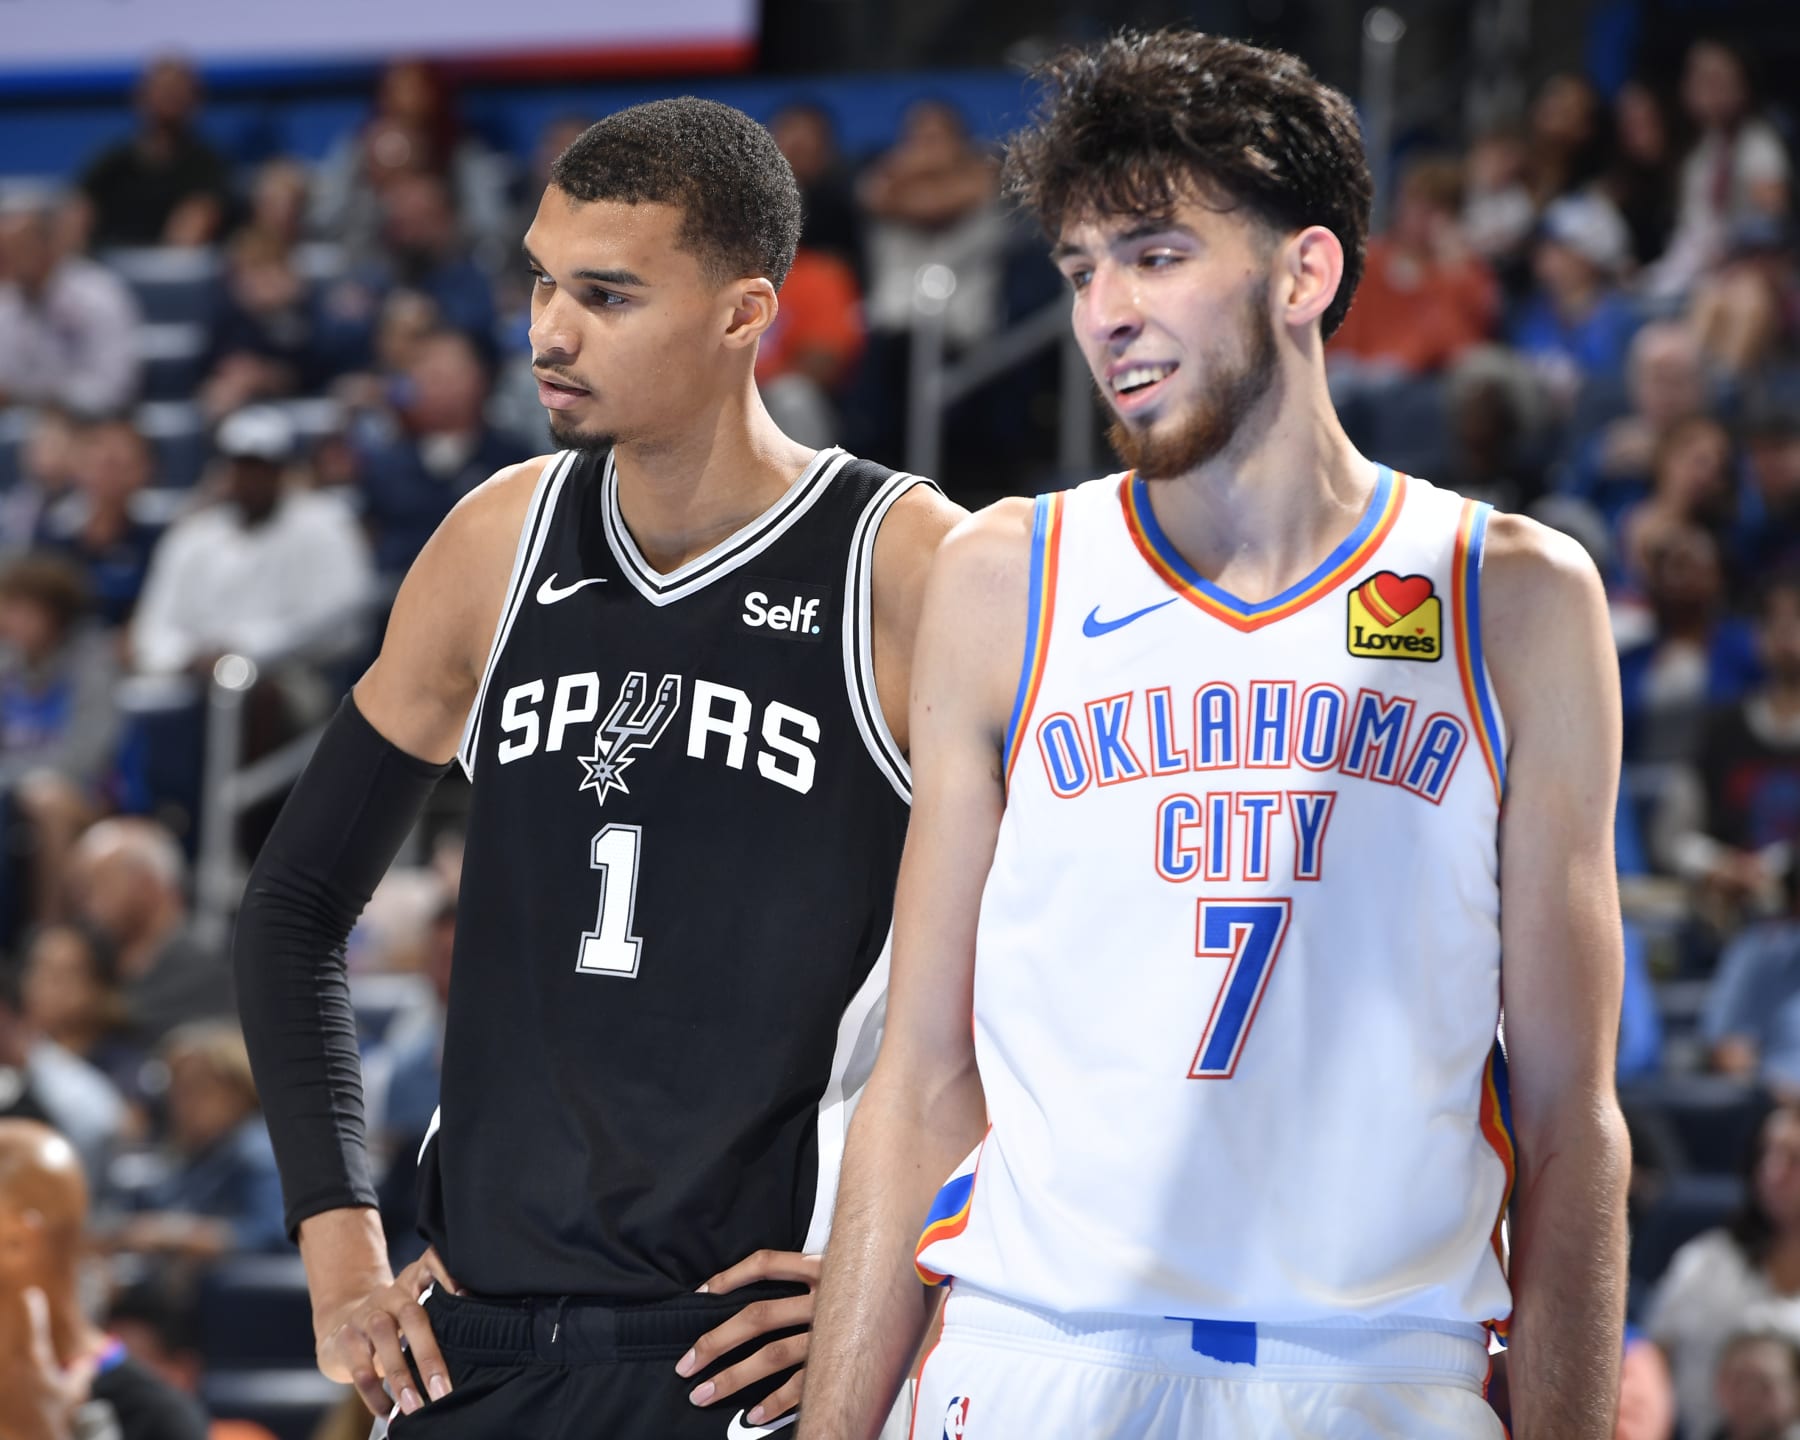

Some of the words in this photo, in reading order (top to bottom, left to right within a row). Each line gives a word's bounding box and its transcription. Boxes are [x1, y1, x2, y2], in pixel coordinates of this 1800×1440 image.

[742, 592, 820, 633] Self.
[498, 671, 820, 806] SPURS
[1036, 680, 1467, 805] OKLAHOMA
[575, 823, 643, 978] 1
[1155, 791, 1337, 883] CITY
[1187, 897, 1292, 1079] 7
